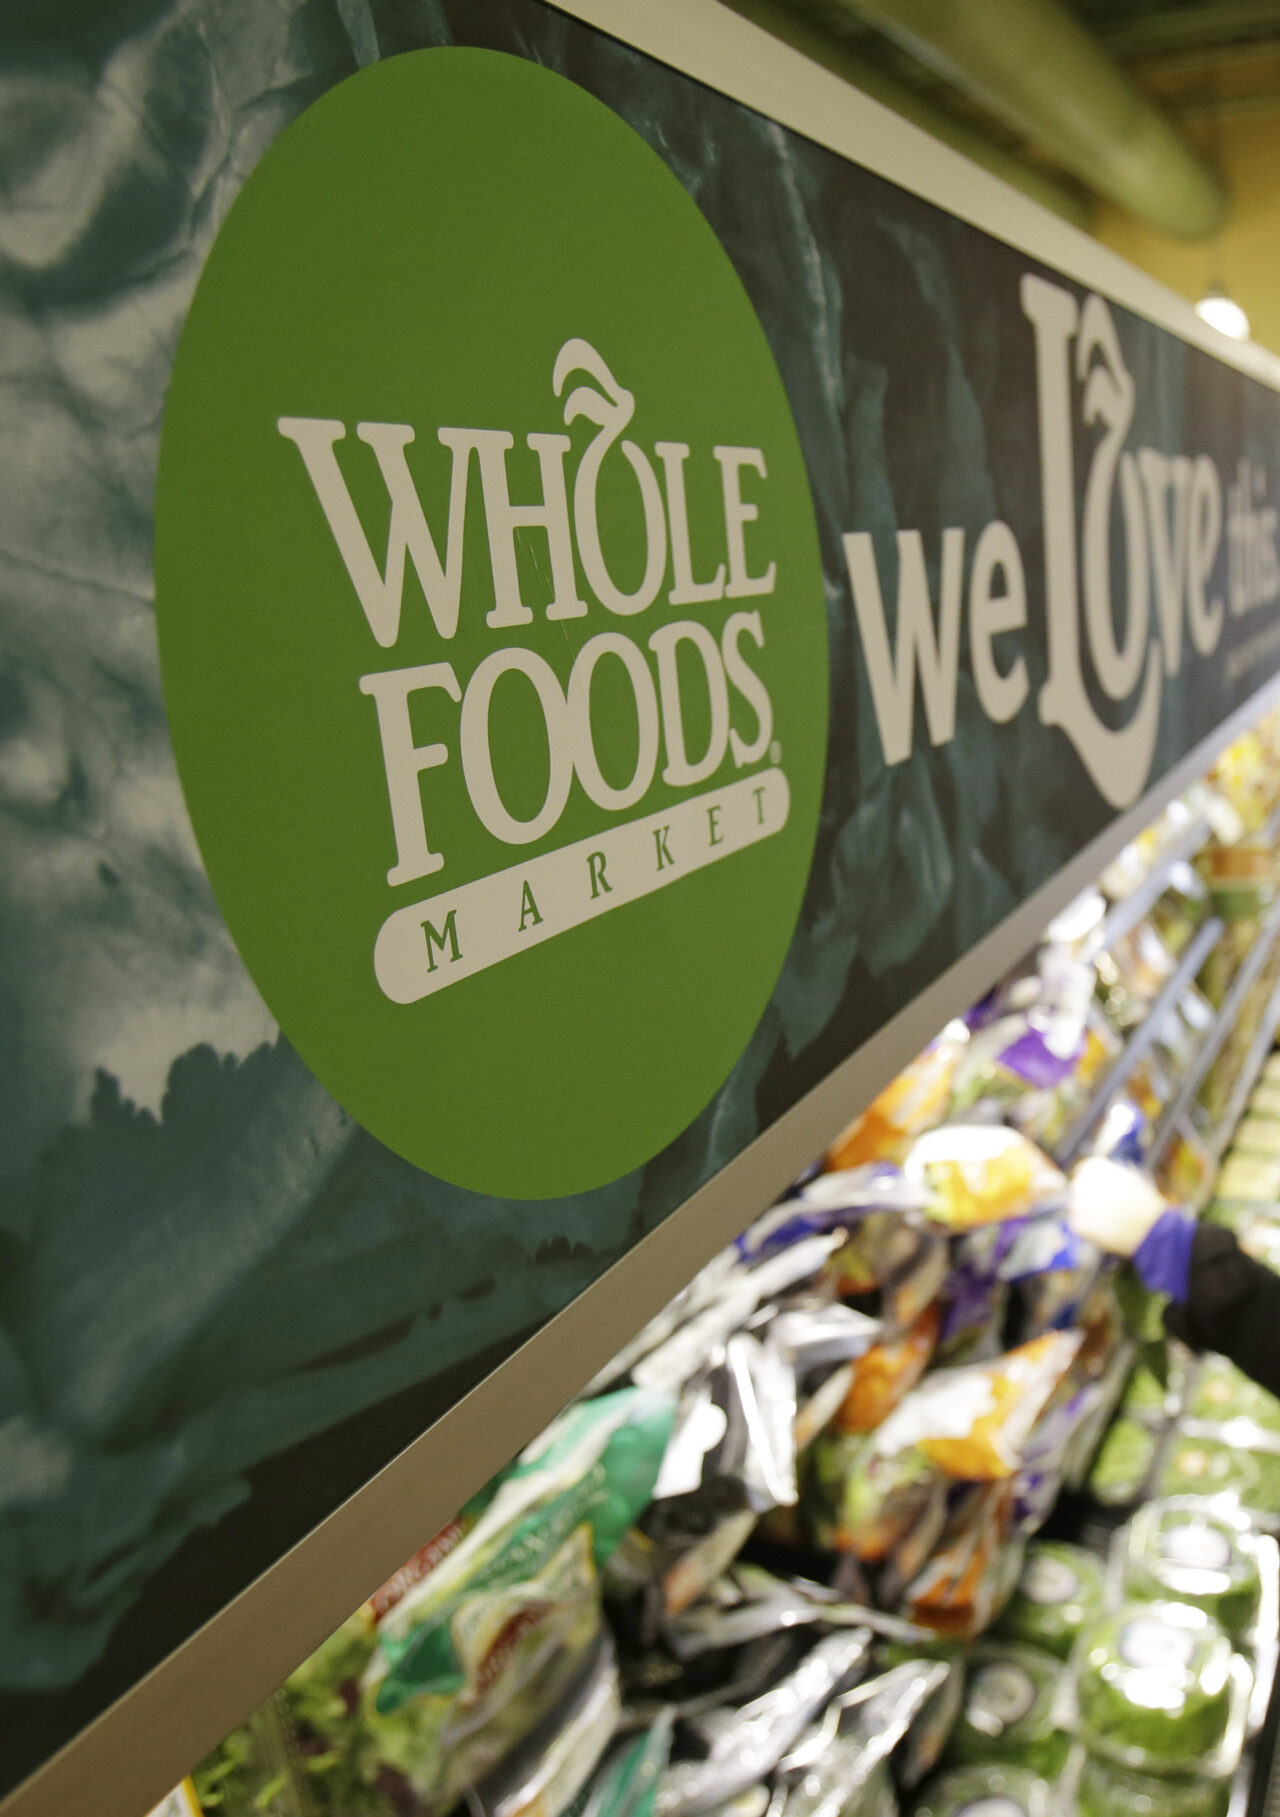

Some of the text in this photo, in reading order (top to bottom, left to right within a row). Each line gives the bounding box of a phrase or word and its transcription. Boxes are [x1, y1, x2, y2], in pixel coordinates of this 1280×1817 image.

[277, 338, 777, 648] WHOLE
[1021, 273, 1225, 810] Love
[359, 611, 774, 887] FOODS
[420, 786, 768, 973] MARKET
